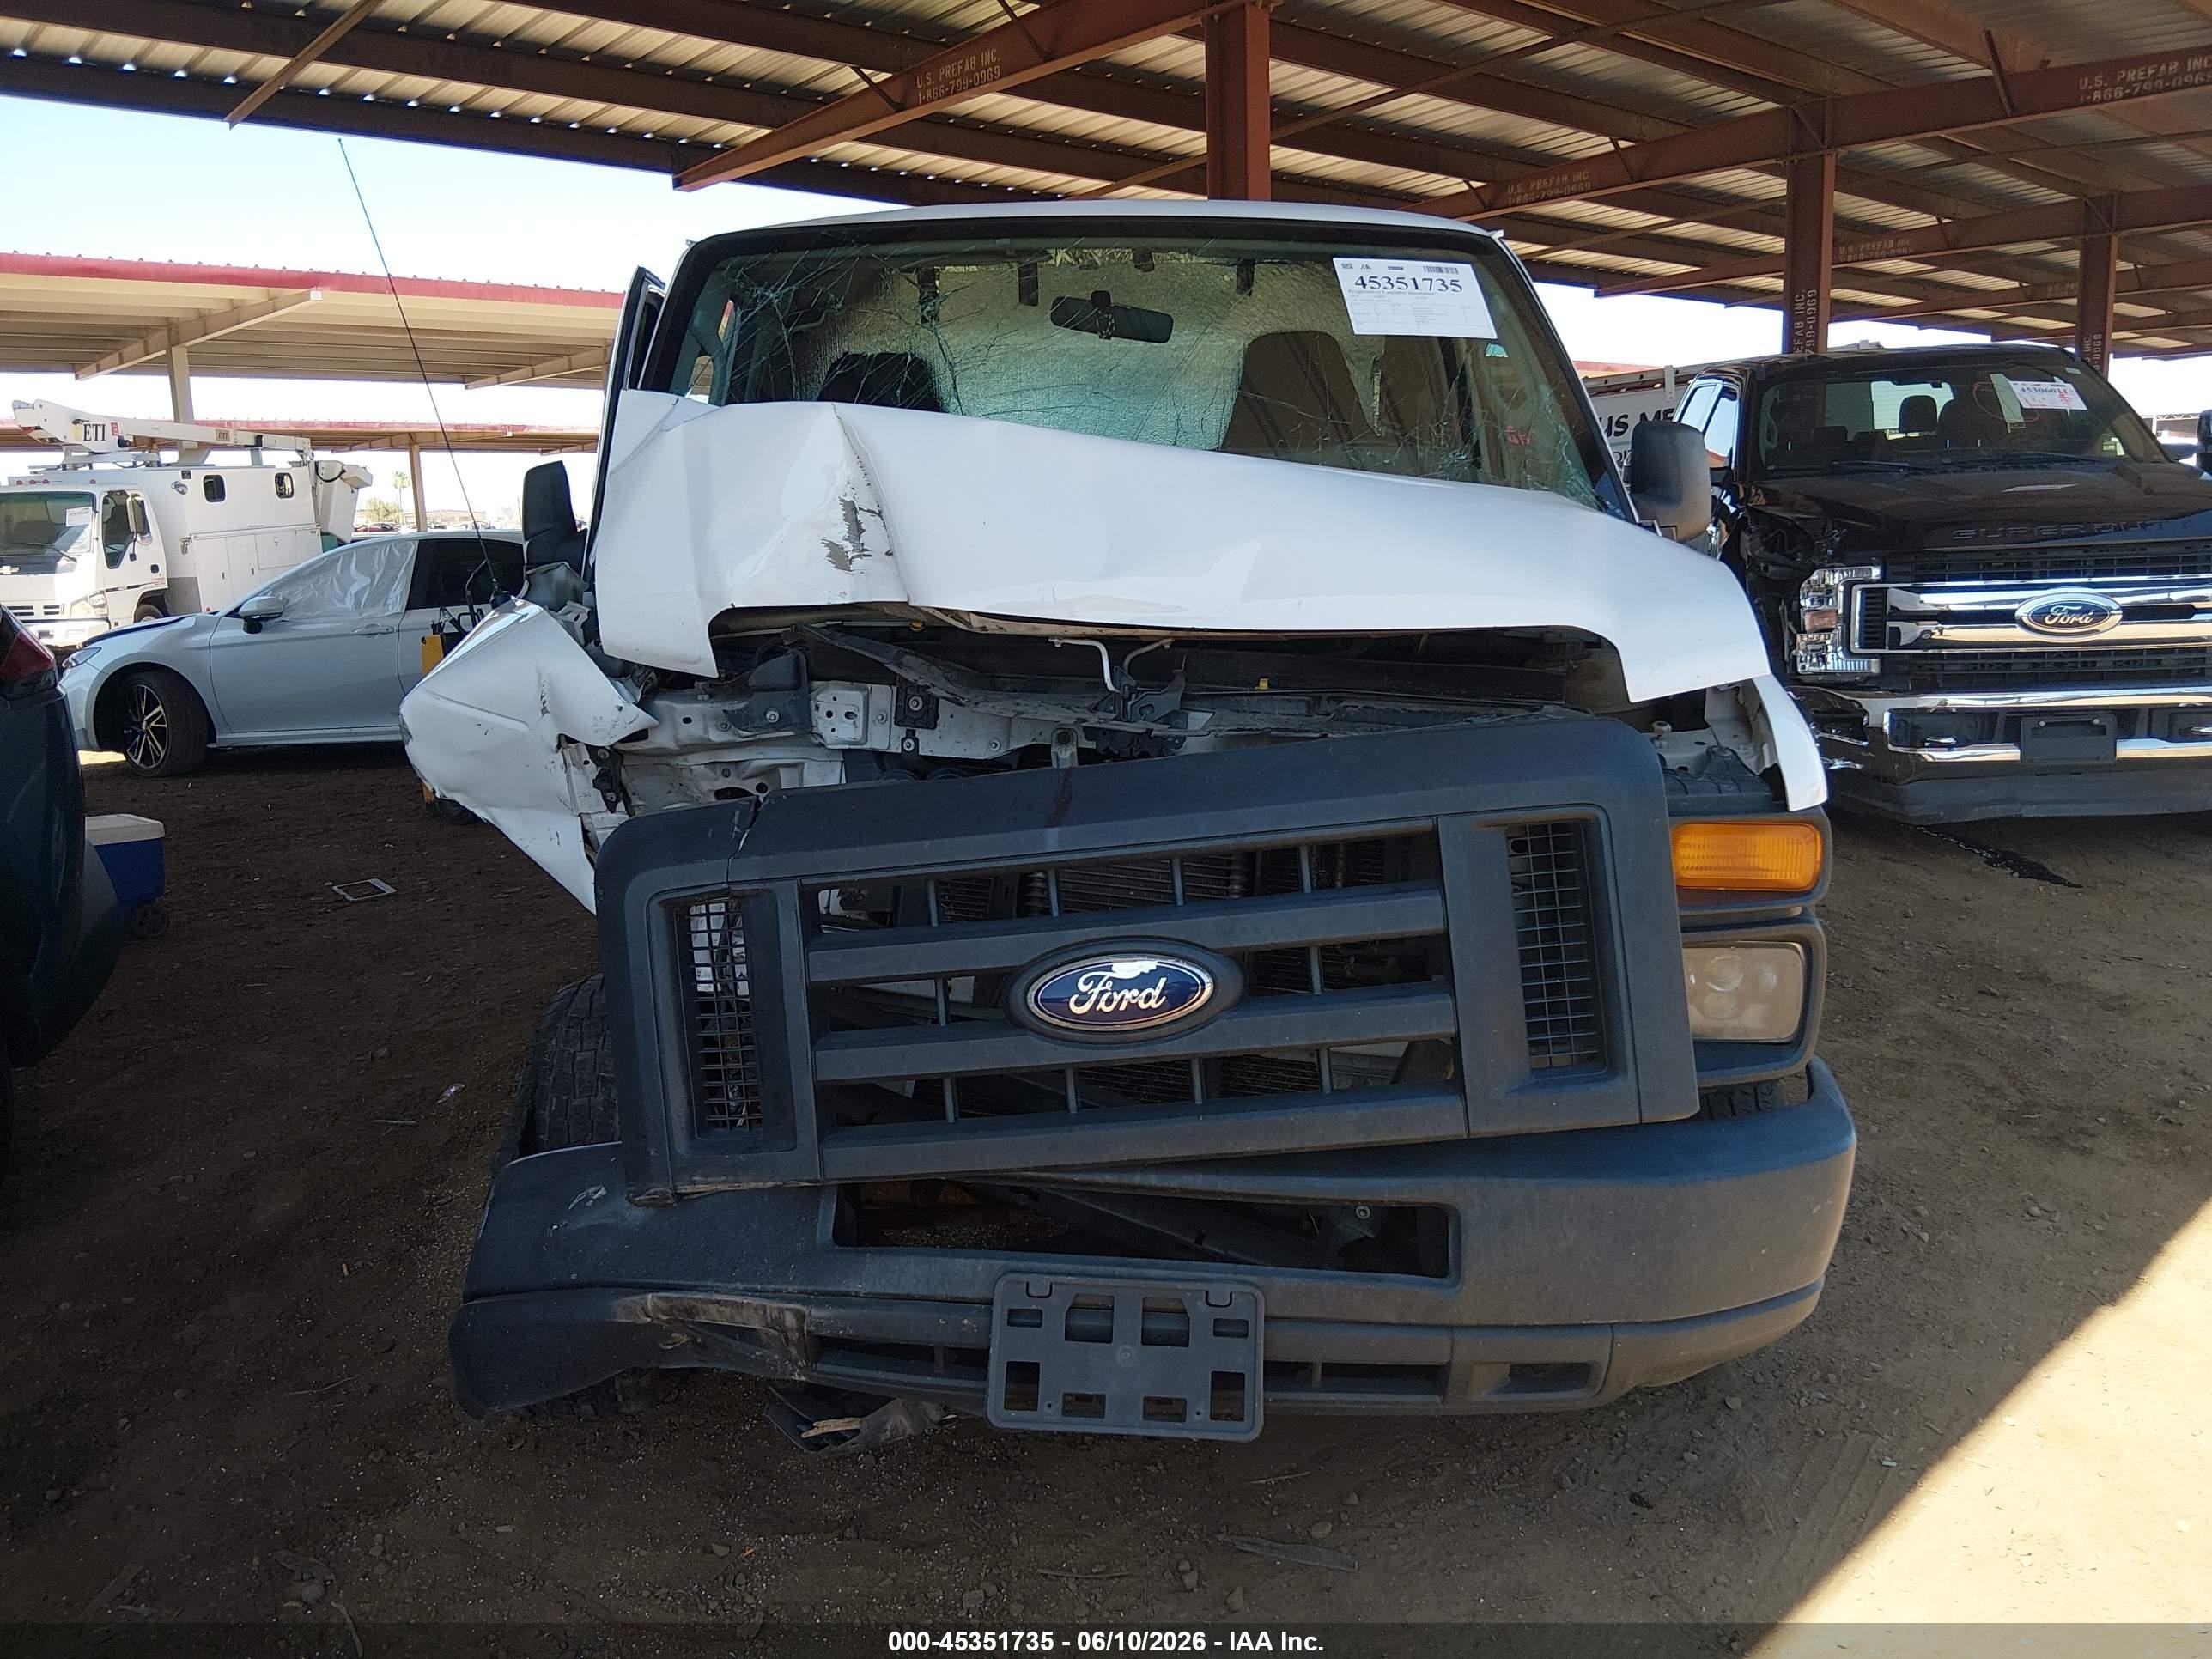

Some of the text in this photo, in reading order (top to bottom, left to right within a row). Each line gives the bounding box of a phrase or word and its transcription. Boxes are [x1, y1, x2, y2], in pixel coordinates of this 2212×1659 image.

[916, 48, 1000, 89] U.S. PREFAB INC.
[2079, 75, 2108, 90] U.S.
[2116, 61, 2179, 82] PREFAB
[918, 65, 1000, 106] 1-866-799-0969
[1530, 173, 1568, 191] PREFAB
[1354, 274, 1463, 294] 45351735
[1792, 321, 1804, 356] EFAB
[83, 423, 106, 441] ETI
[1952, 523, 2084, 541] SUPER
[2044, 605, 2094, 625] Ford
[1069, 971, 1167, 1015] Ford
